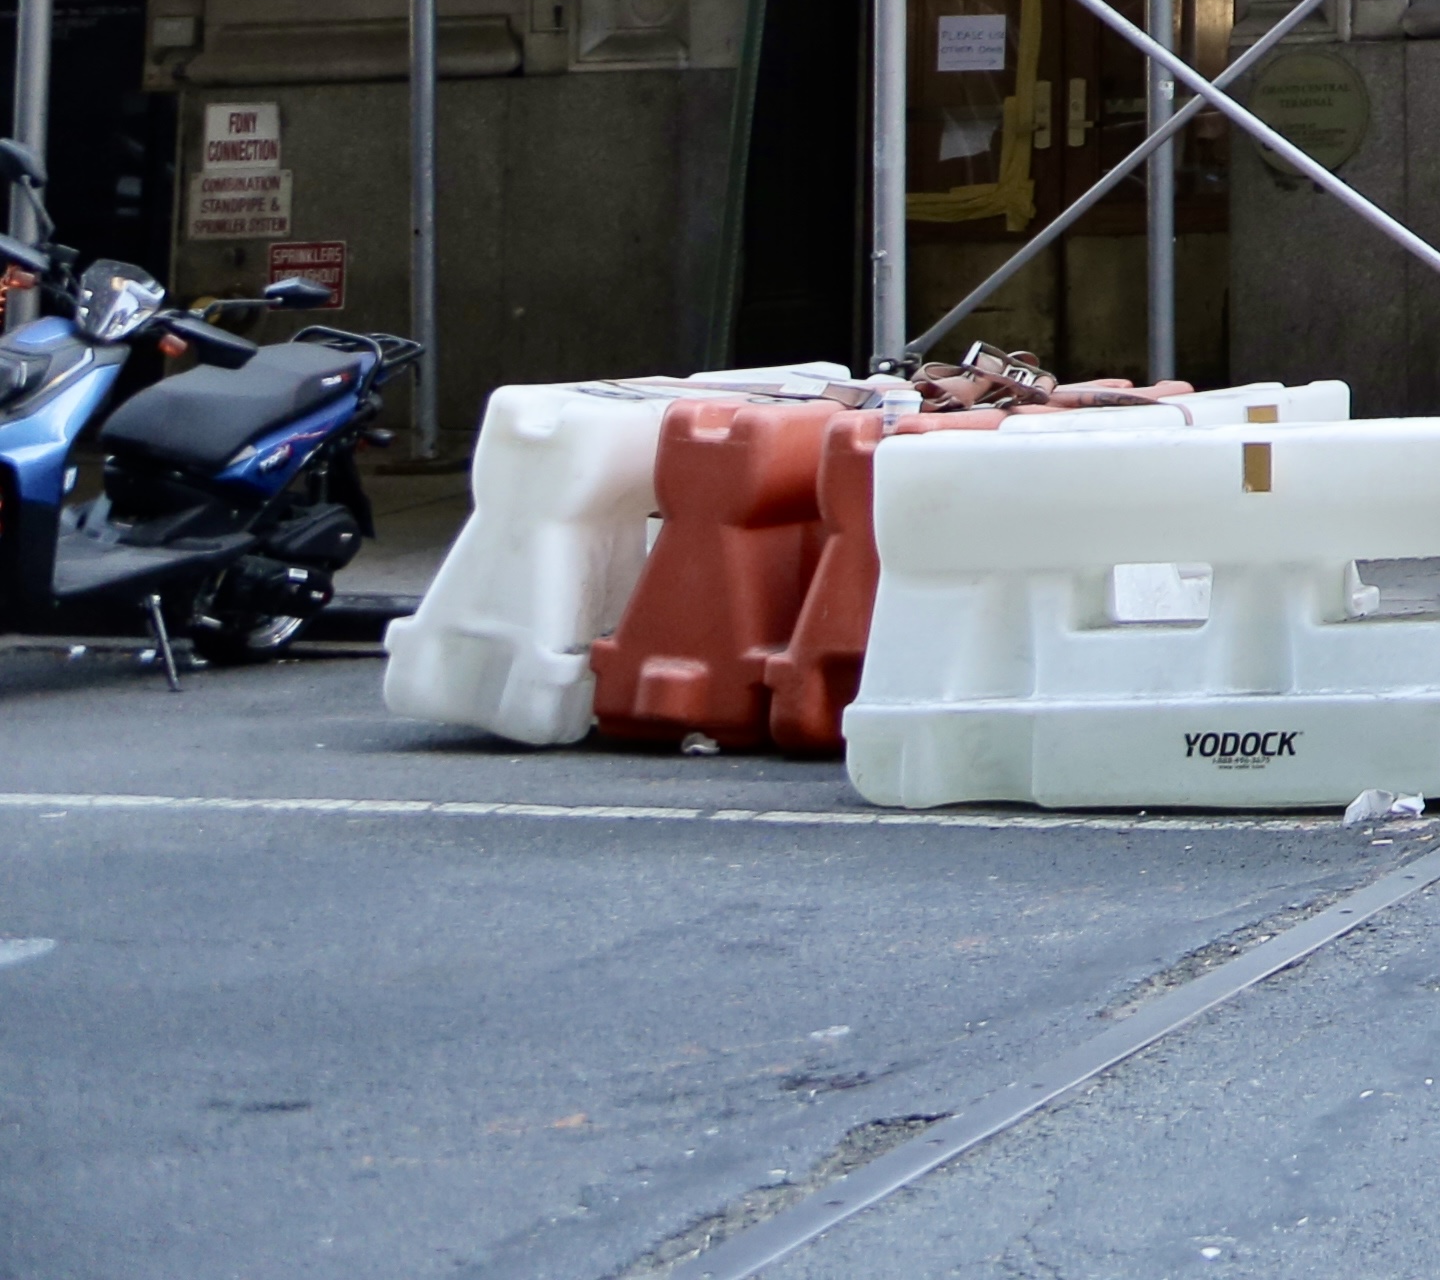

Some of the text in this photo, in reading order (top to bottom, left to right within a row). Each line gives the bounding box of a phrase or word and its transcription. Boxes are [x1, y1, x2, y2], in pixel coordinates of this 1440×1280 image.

[229, 112, 258, 134] FDNY
[208, 140, 278, 162] CONNECTION
[201, 198, 280, 214] STANDPIPE &
[272, 247, 342, 264] SPRINKLERS
[1184, 731, 1298, 757] YODOCK
